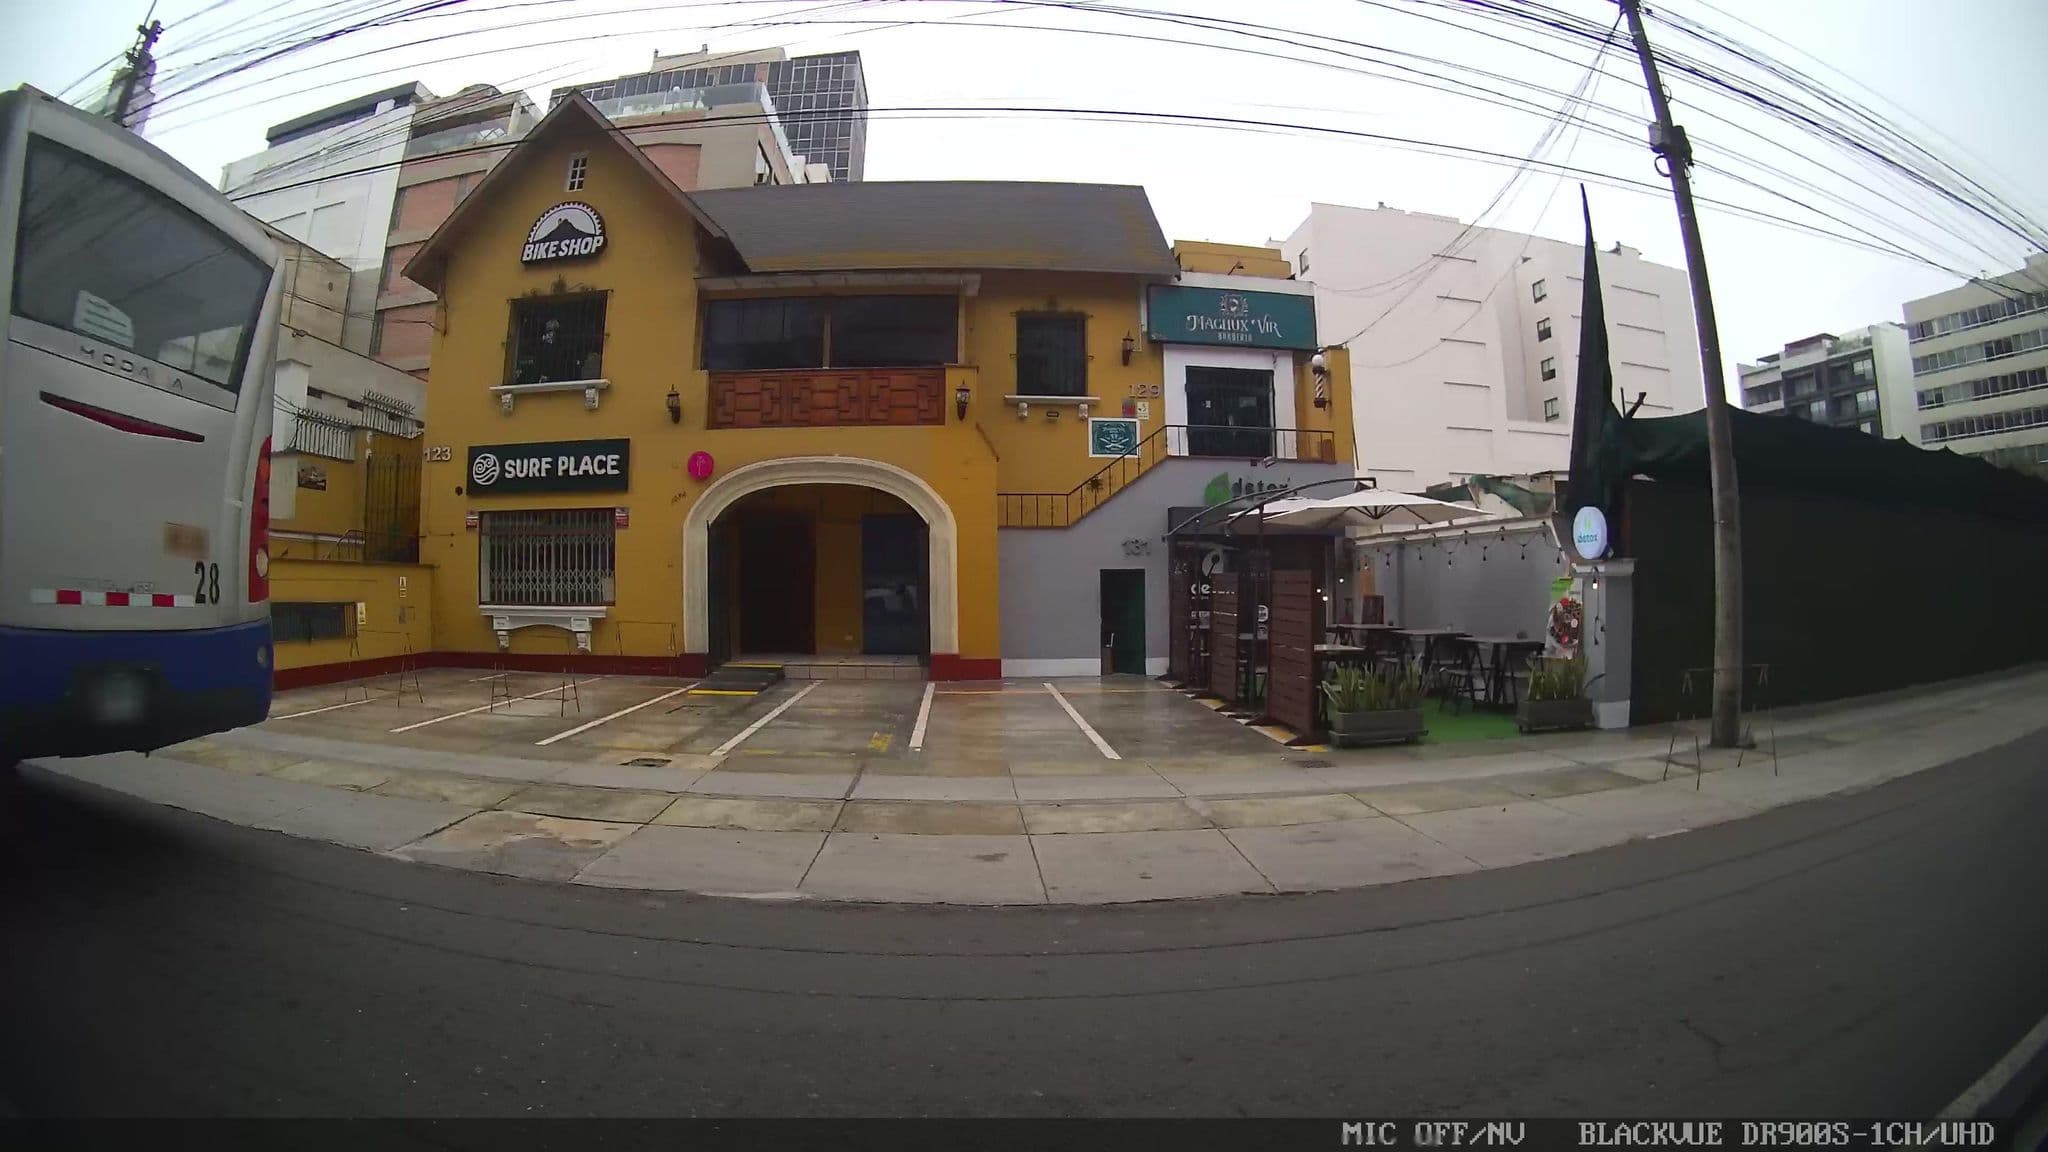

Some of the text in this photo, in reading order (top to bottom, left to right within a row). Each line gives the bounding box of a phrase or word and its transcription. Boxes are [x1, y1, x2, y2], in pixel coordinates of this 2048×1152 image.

[522, 235, 604, 261] BIKE SHOP
[80, 345, 183, 391] MODAA
[1128, 384, 1160, 399] 129
[424, 446, 451, 462] 123
[504, 454, 621, 479] SURF PLACE
[1577, 531, 1598, 544] detox
[194, 561, 220, 605] 28
